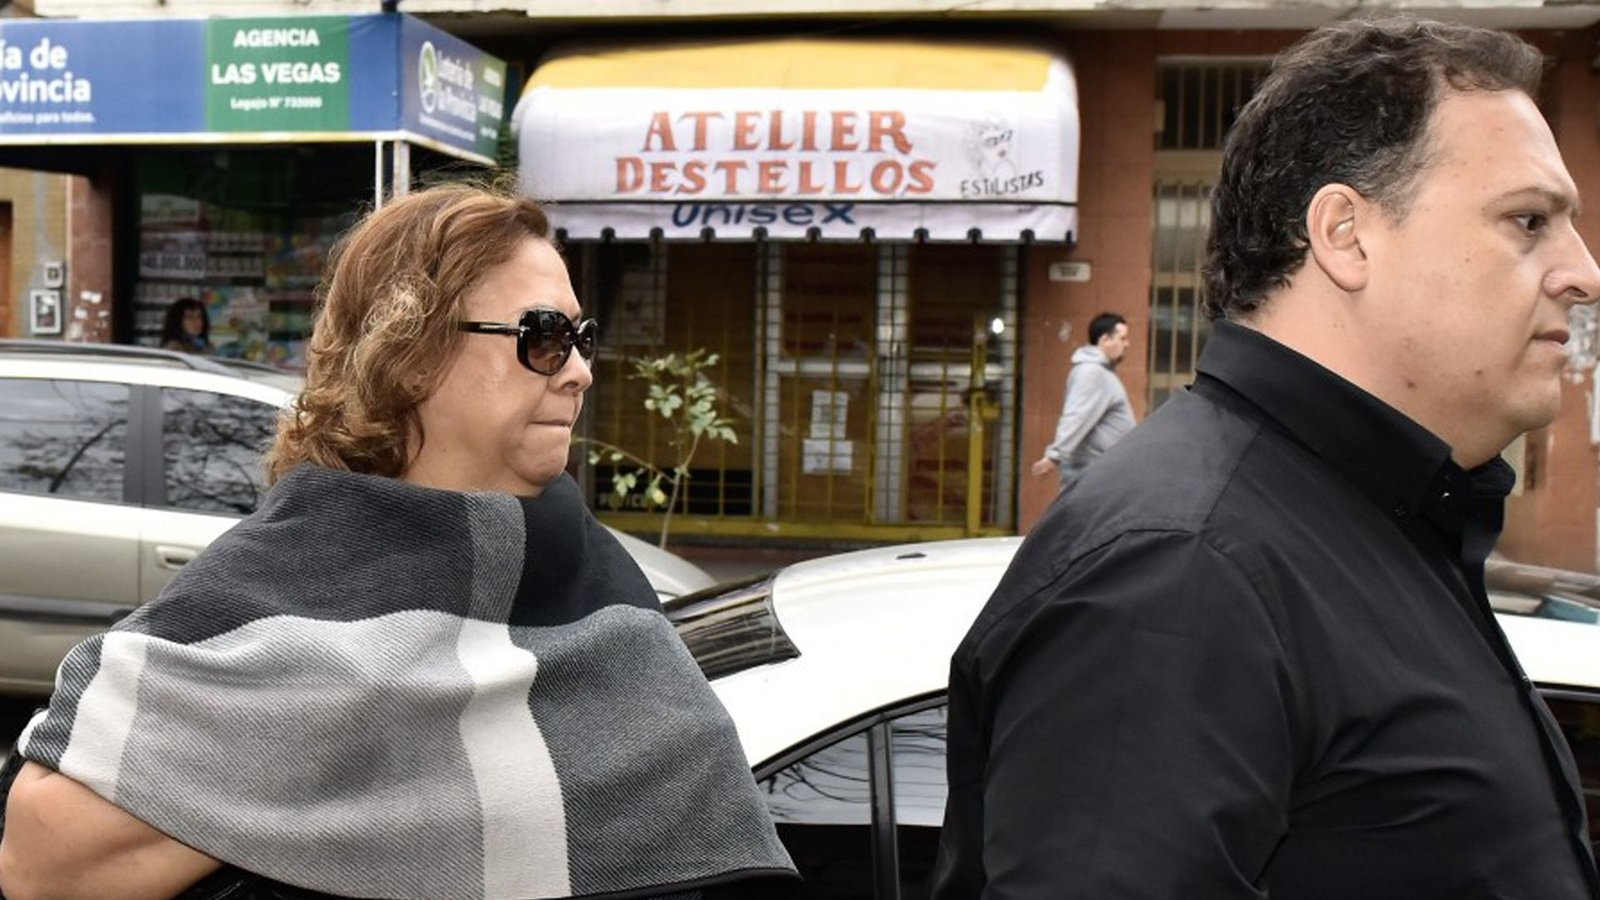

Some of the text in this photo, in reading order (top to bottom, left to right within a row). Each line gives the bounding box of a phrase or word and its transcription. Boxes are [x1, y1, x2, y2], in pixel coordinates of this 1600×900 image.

[29, 37, 69, 70] de
[233, 28, 320, 48] AGENCIA
[0, 71, 92, 103] vincia
[211, 61, 341, 85] LAS VEGAS
[642, 109, 914, 154] ATELIER
[612, 156, 938, 196] DESTELLOS
[960, 170, 1044, 199] ESTILISTAS
